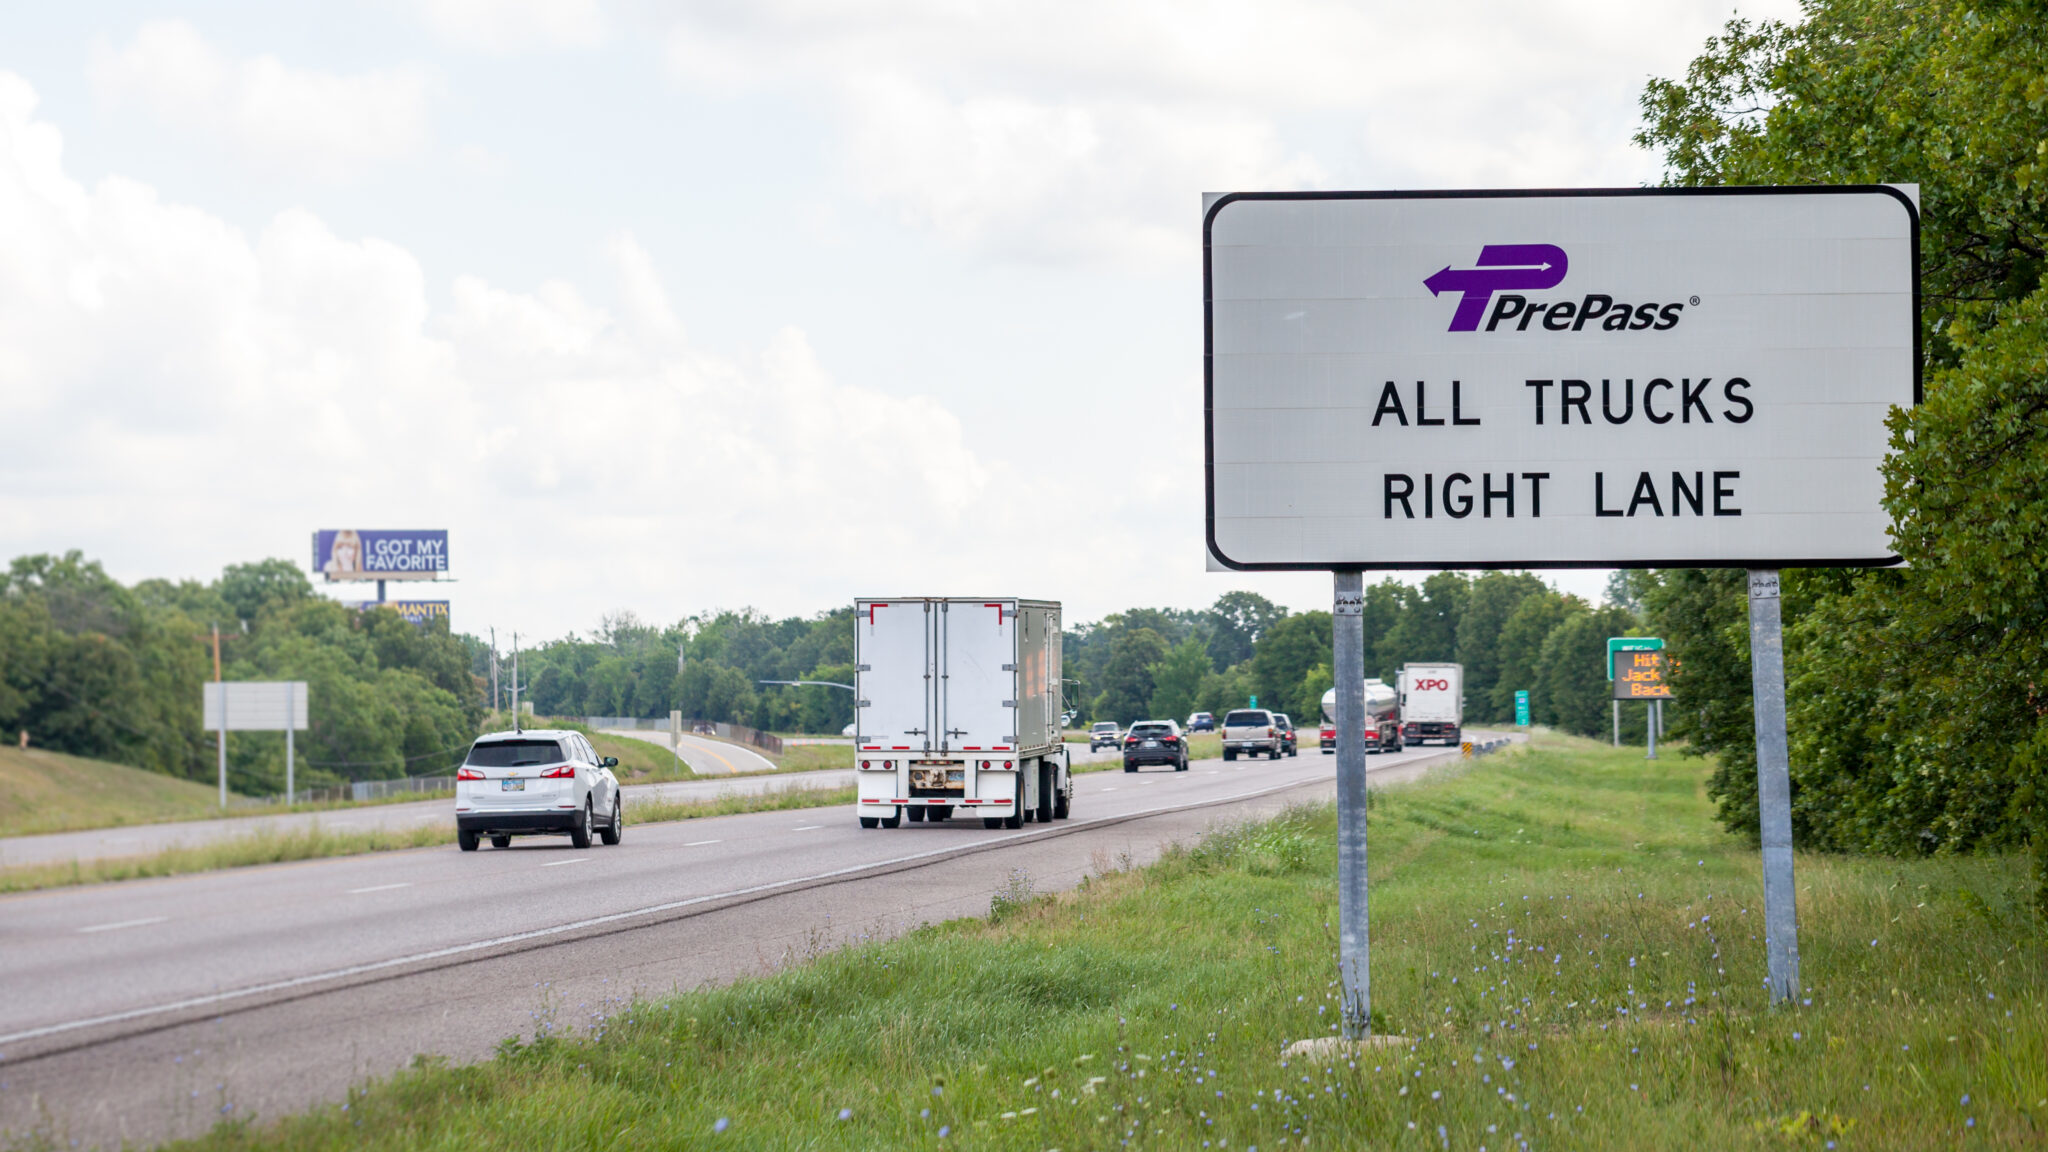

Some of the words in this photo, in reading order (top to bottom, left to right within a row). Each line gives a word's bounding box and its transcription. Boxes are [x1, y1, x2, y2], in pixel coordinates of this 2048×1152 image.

[1371, 380, 1481, 426] ALL
[1525, 377, 1754, 425] TRUCKS
[1384, 472, 1550, 519] RIGHT
[1595, 470, 1742, 517] LANE
[375, 539, 412, 555] GOT
[417, 539, 443, 554] MY
[366, 555, 445, 570] FAVORITE
[1634, 654, 1660, 667] Hit
[1622, 669, 1661, 681] Jack
[1415, 679, 1448, 691] XPO
[1631, 683, 1671, 696] Back
